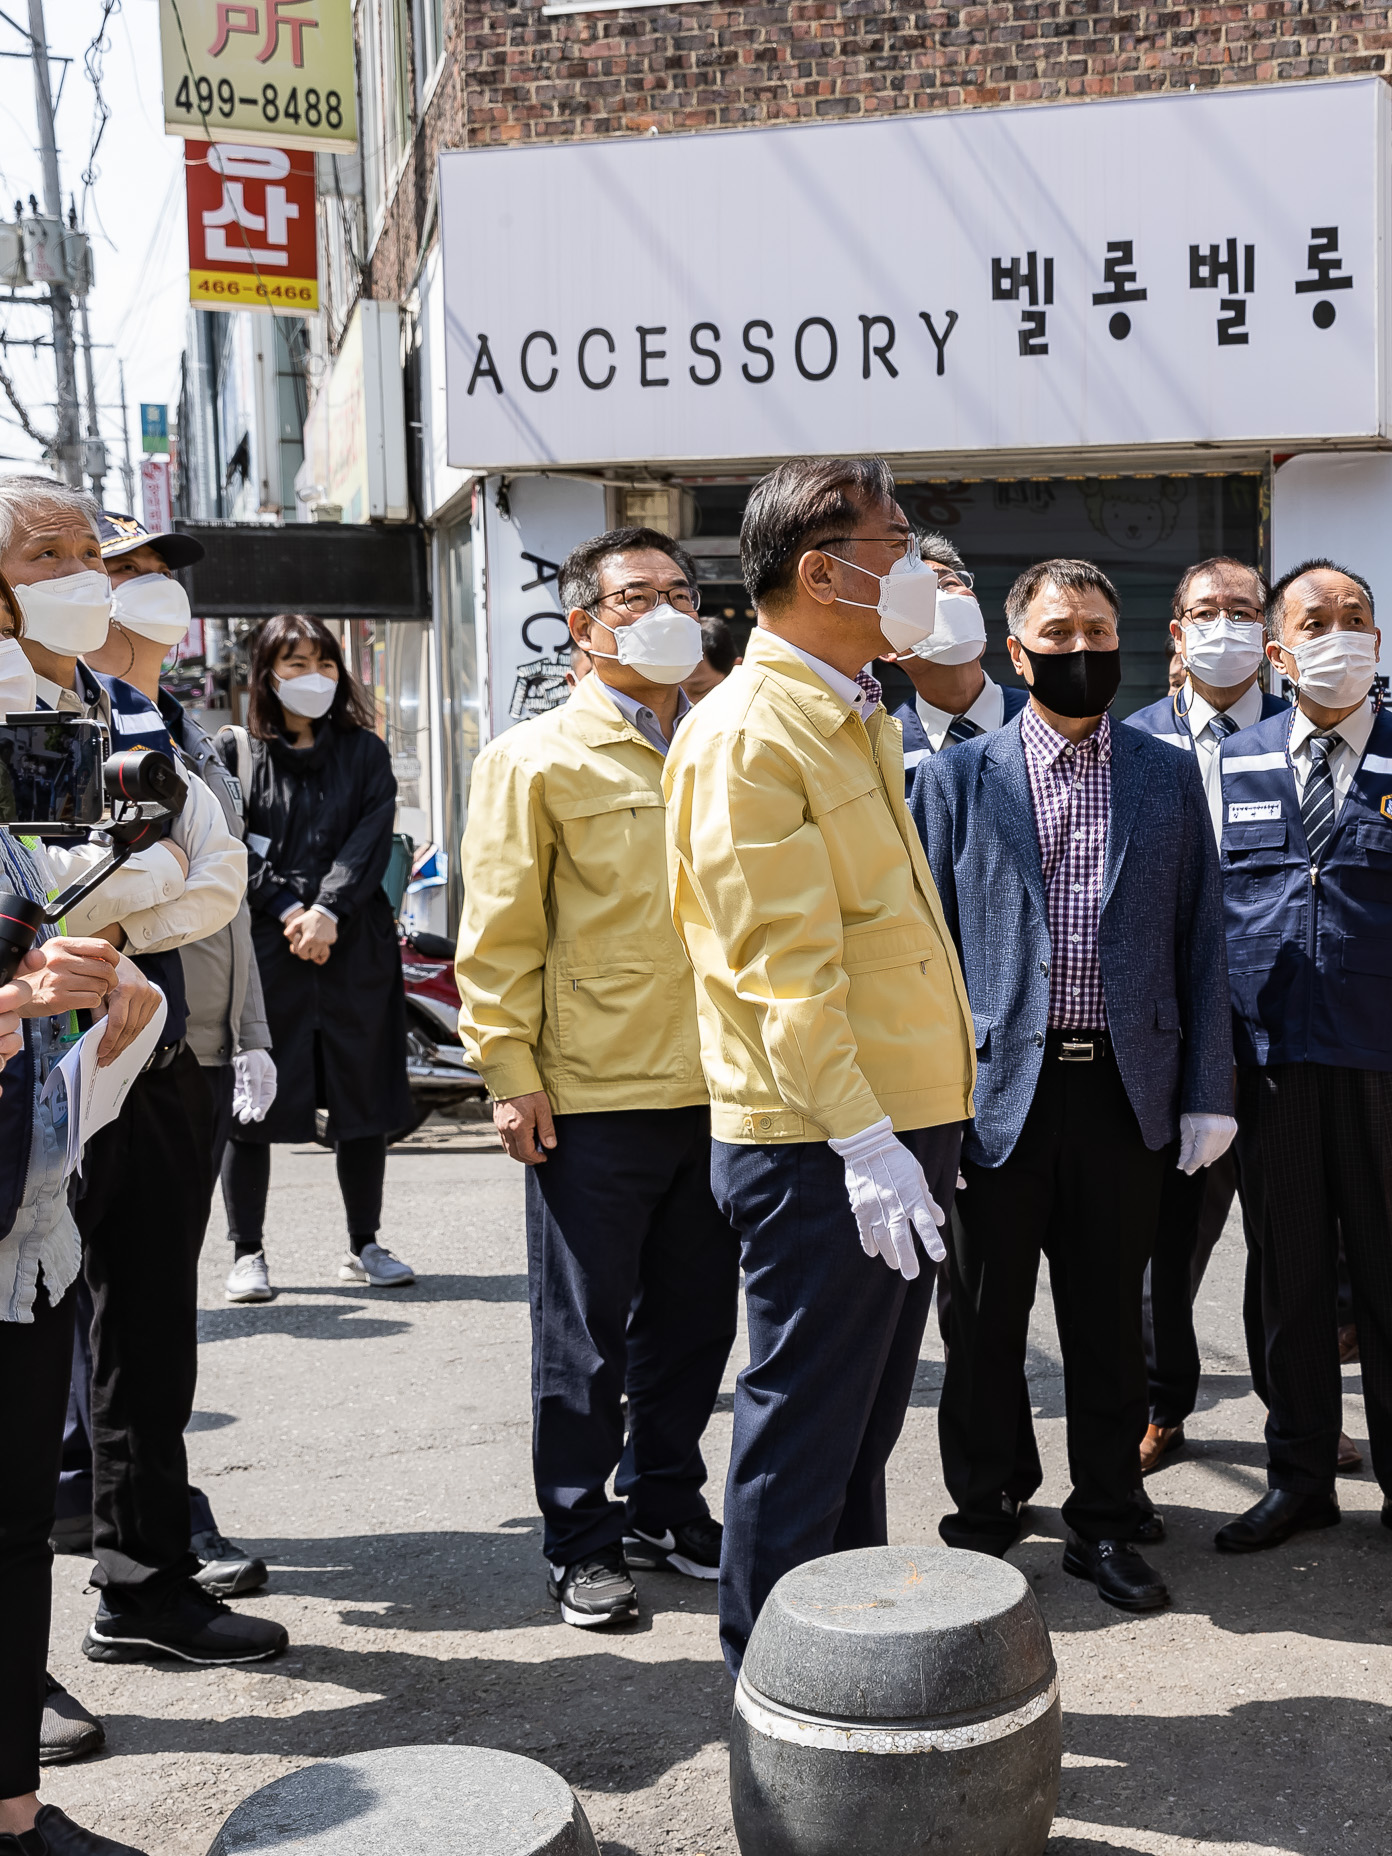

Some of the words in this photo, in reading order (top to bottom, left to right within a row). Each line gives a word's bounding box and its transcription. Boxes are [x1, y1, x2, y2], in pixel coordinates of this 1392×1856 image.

[174, 74, 343, 130] 499-8488
[197, 279, 312, 302] 466-6466
[466, 310, 959, 396] ACCESSORY
